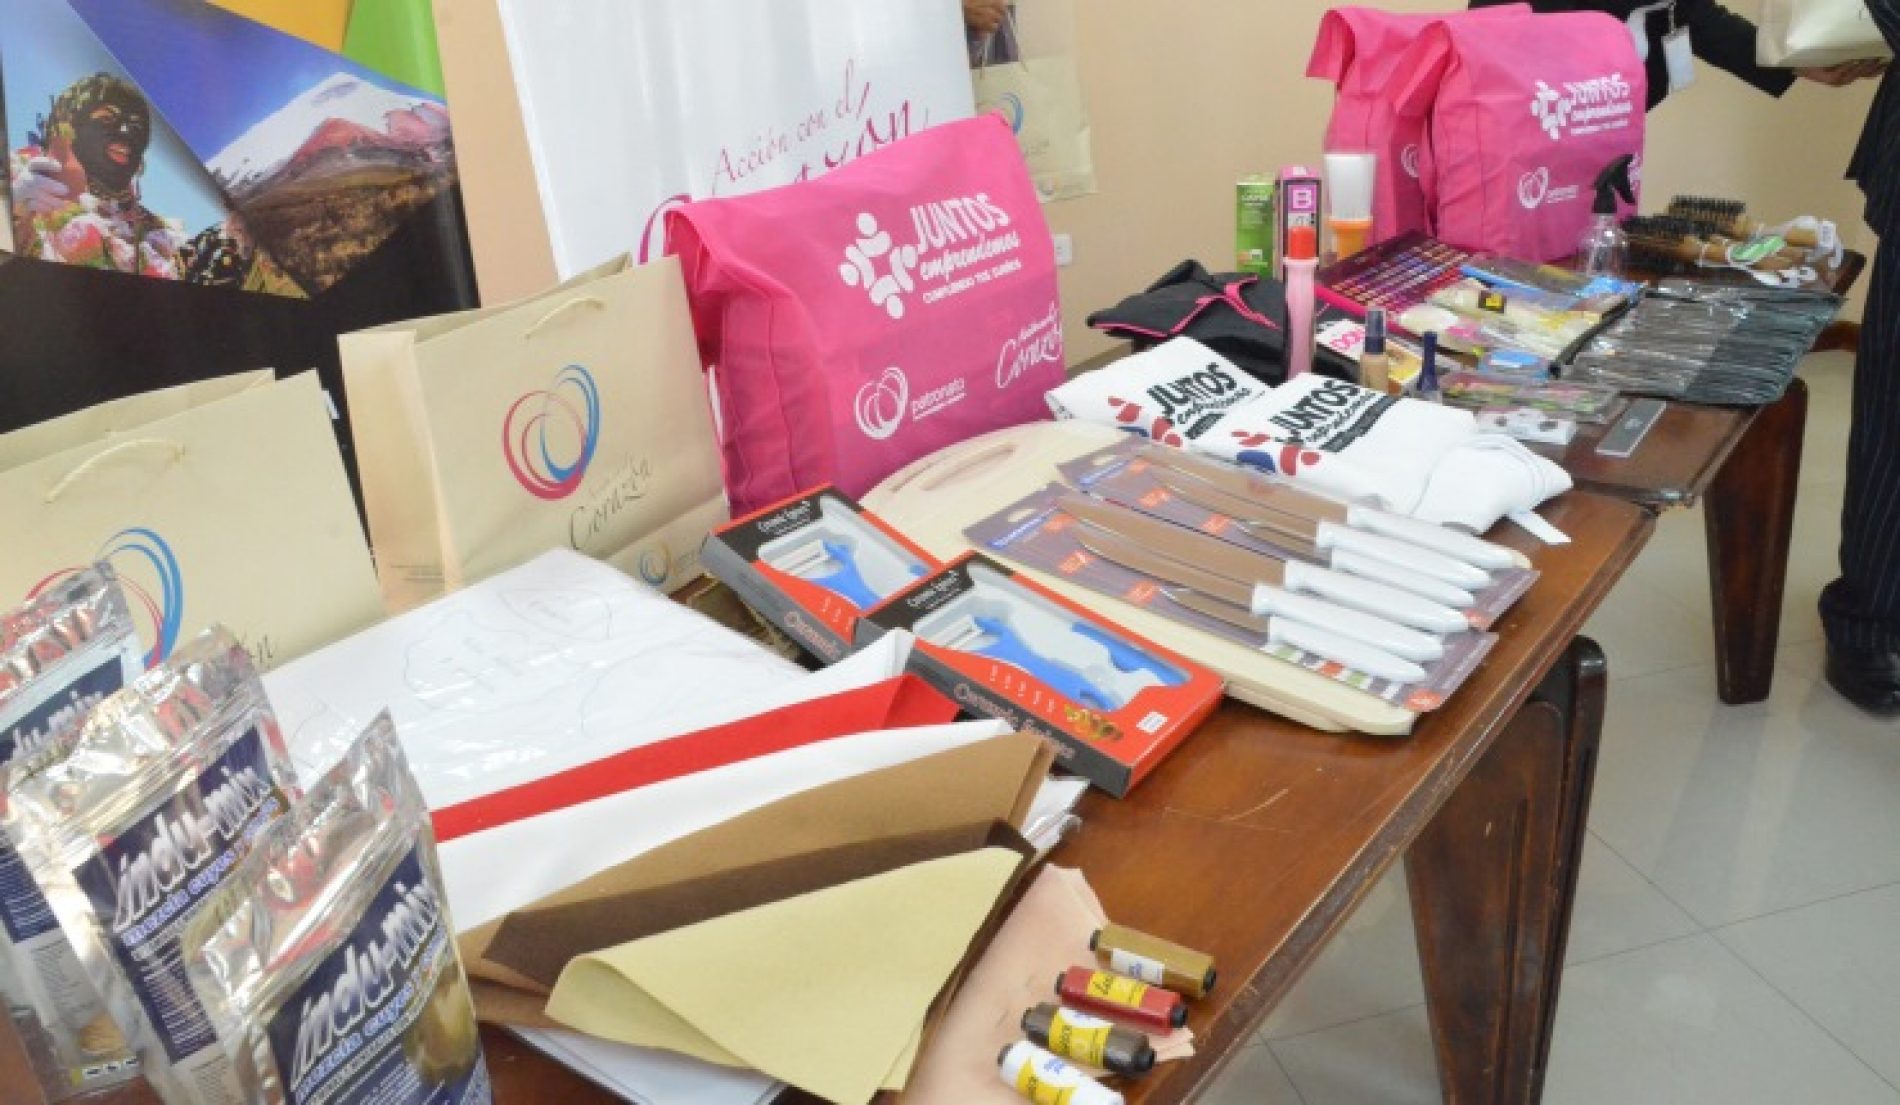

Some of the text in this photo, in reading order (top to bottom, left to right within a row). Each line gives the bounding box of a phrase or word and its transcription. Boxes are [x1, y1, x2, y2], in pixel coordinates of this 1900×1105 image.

[711, 125, 788, 195] Acción
[797, 108, 827, 143] con
[834, 57, 855, 119] el
[910, 192, 1011, 255] JUNTOS
[1146, 362, 1238, 418] JUNTOS
[1269, 380, 1360, 443] JUNTOS
